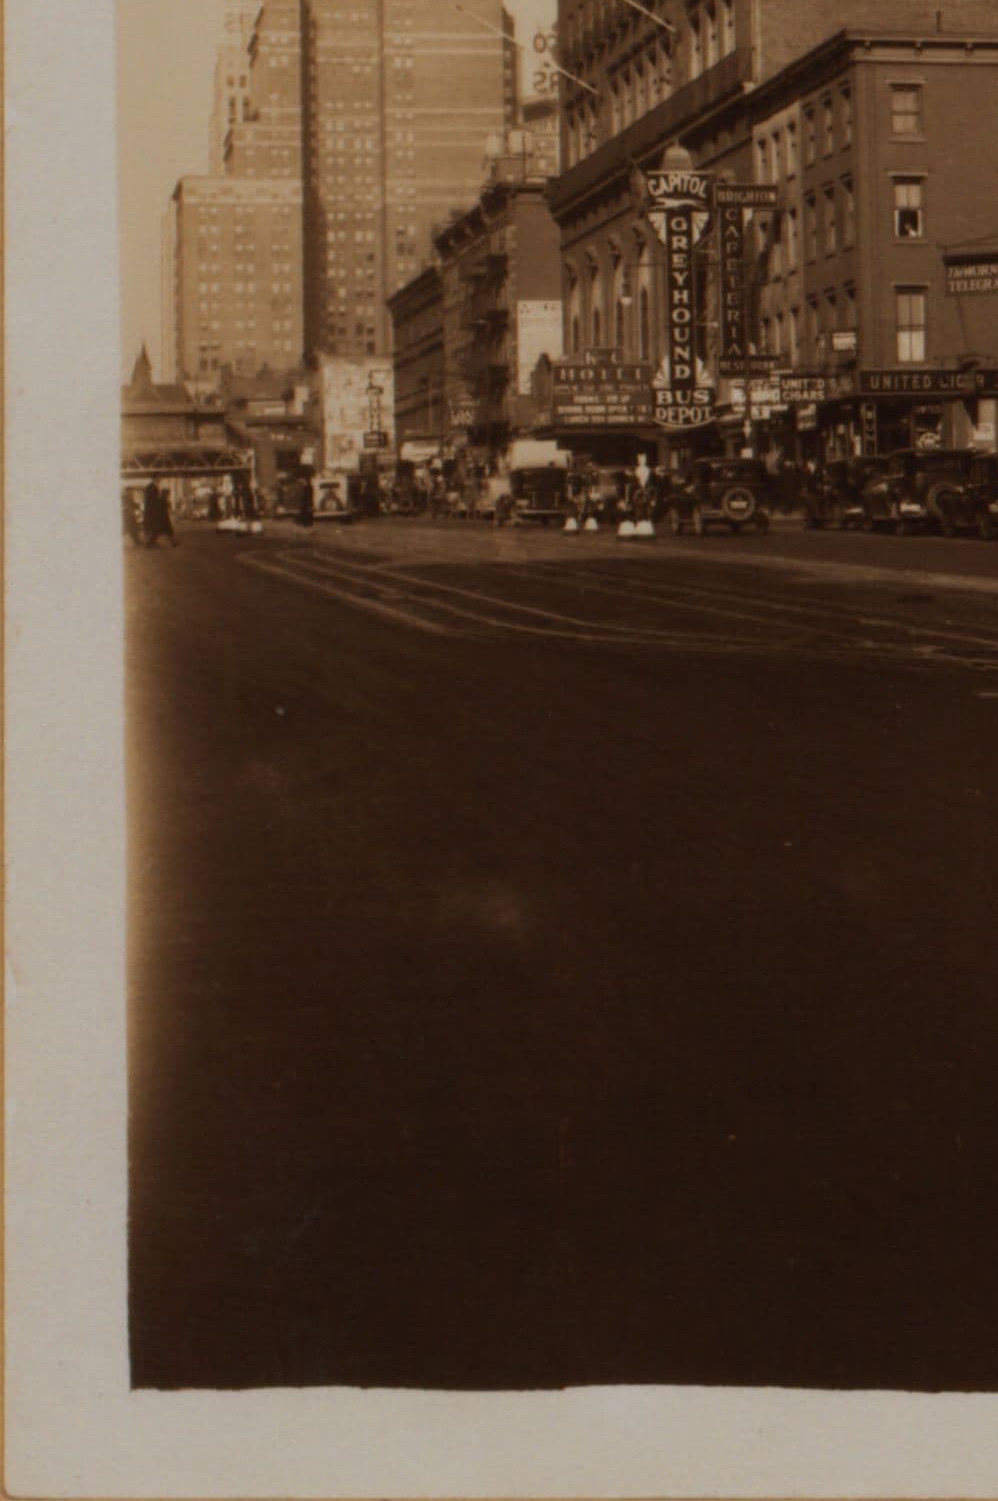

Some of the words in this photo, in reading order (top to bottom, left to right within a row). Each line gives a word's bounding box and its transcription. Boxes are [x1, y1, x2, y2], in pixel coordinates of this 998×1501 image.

[648, 173, 707, 199] CAPITOL
[670, 216, 692, 381] GREYHOUND
[870, 374, 933, 389] UNITED
[656, 390, 710, 405] BUS
[782, 390, 826, 401] CIGARS
[656, 407, 714, 424] DEPOT
